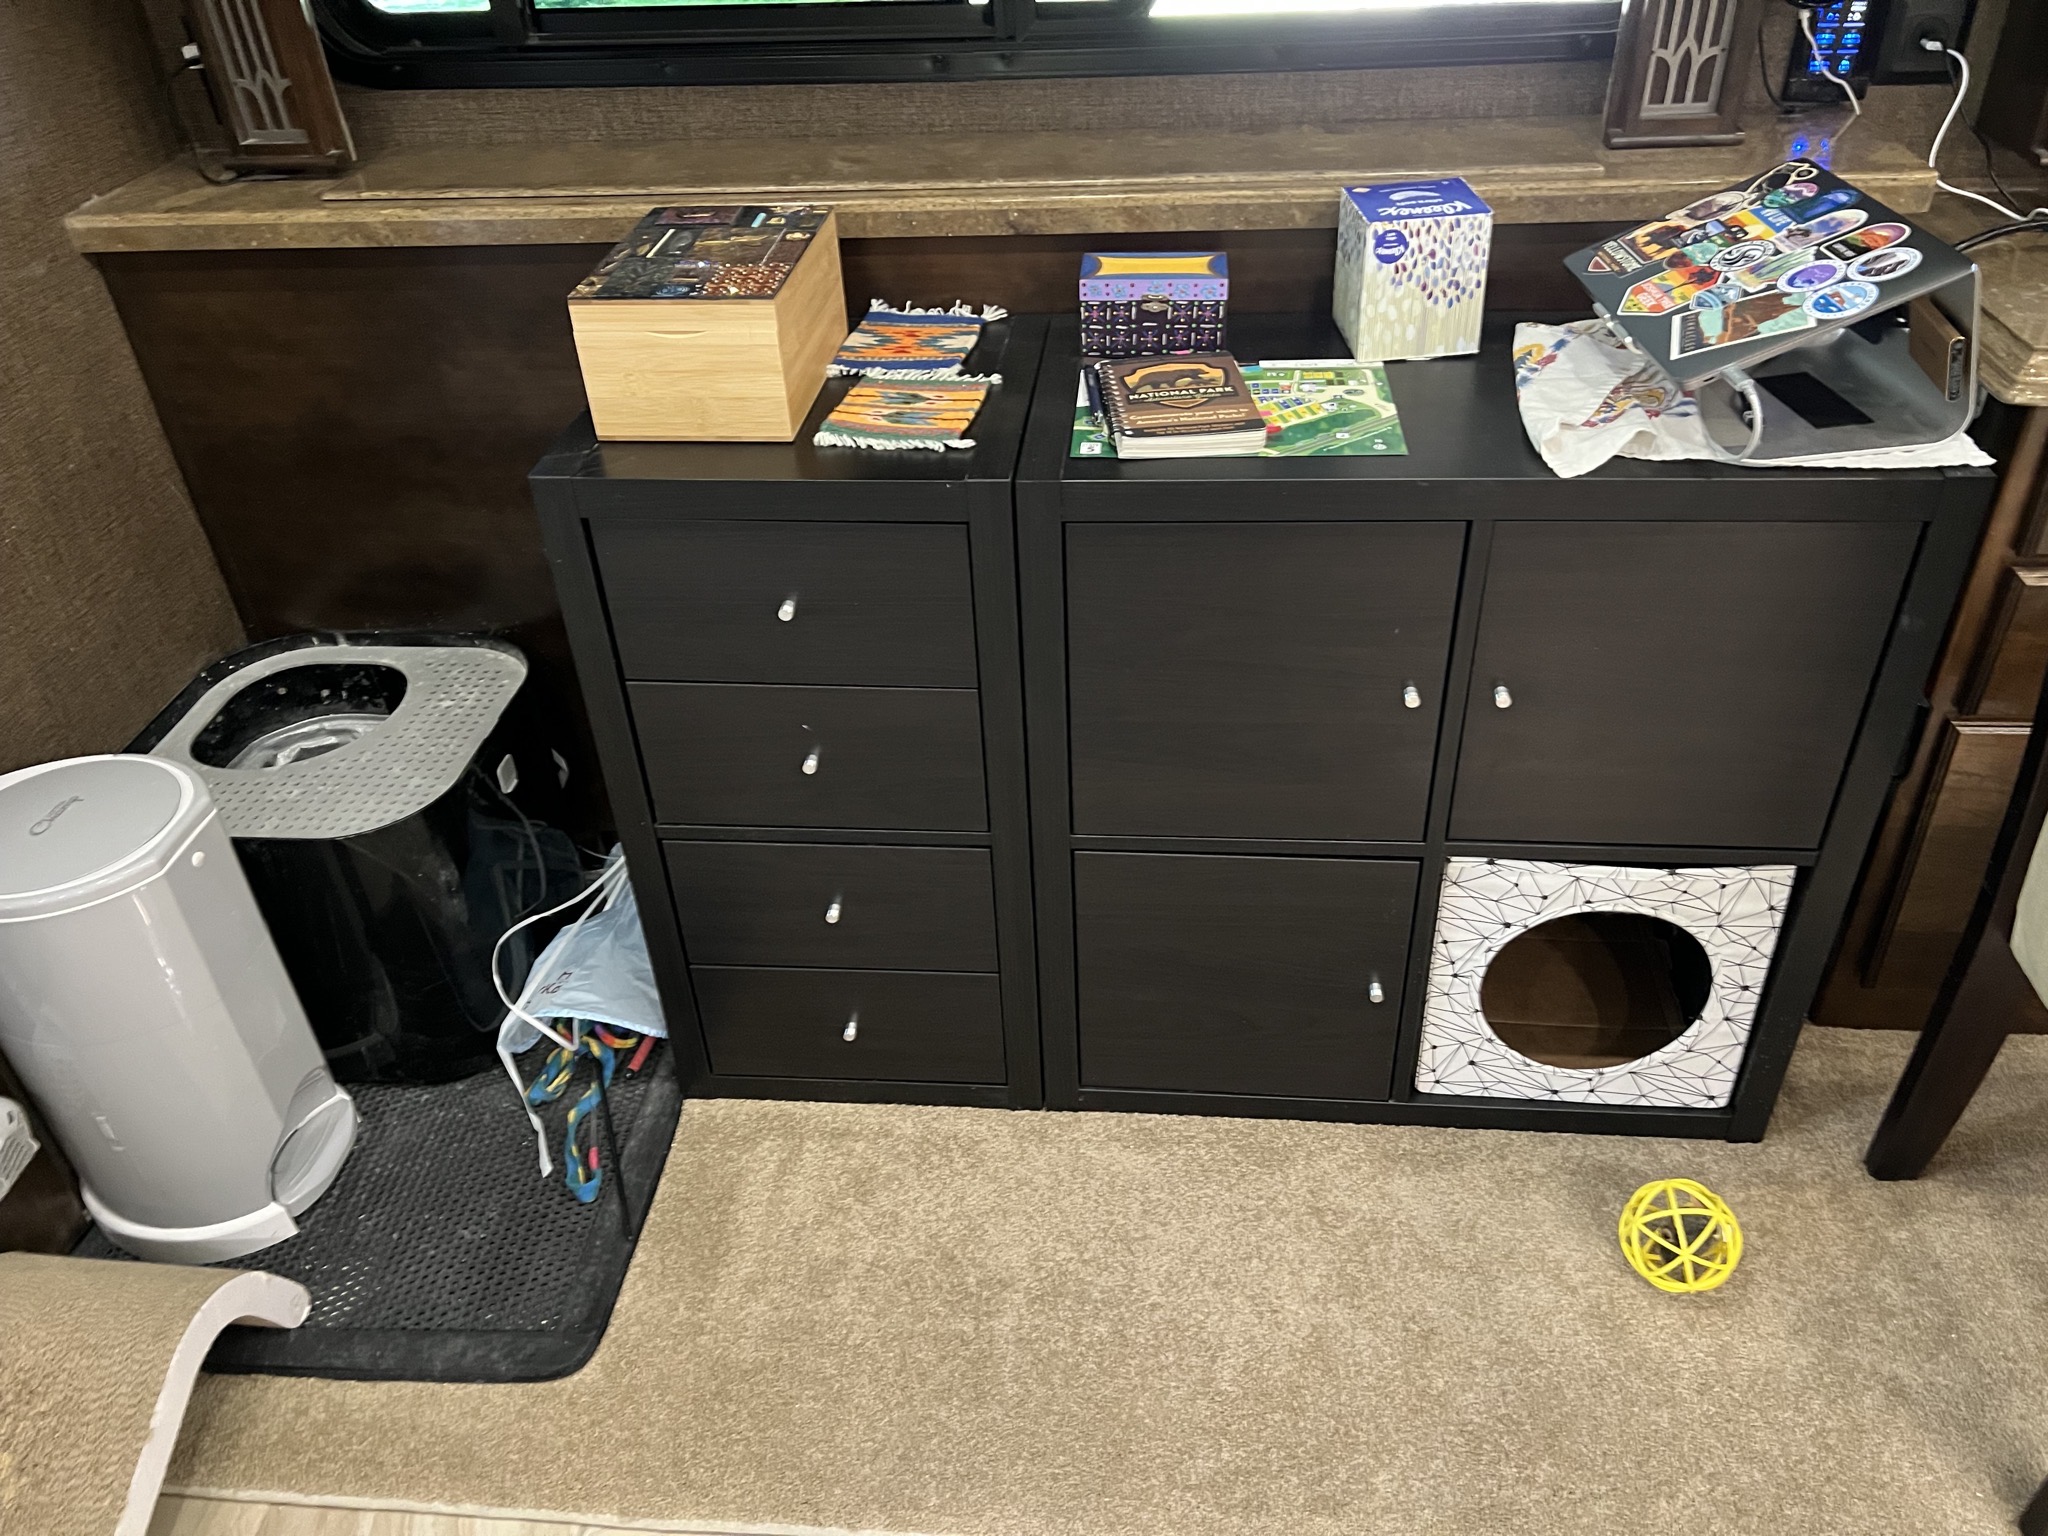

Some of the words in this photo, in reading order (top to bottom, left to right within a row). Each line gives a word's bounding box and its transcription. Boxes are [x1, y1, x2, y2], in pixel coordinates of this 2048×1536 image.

[1377, 201, 1472, 215] Kleenex
[1601, 240, 1642, 272] YELLOWSTONE
[1129, 388, 1196, 400] NATIONAL
[1198, 386, 1235, 394] PARK
